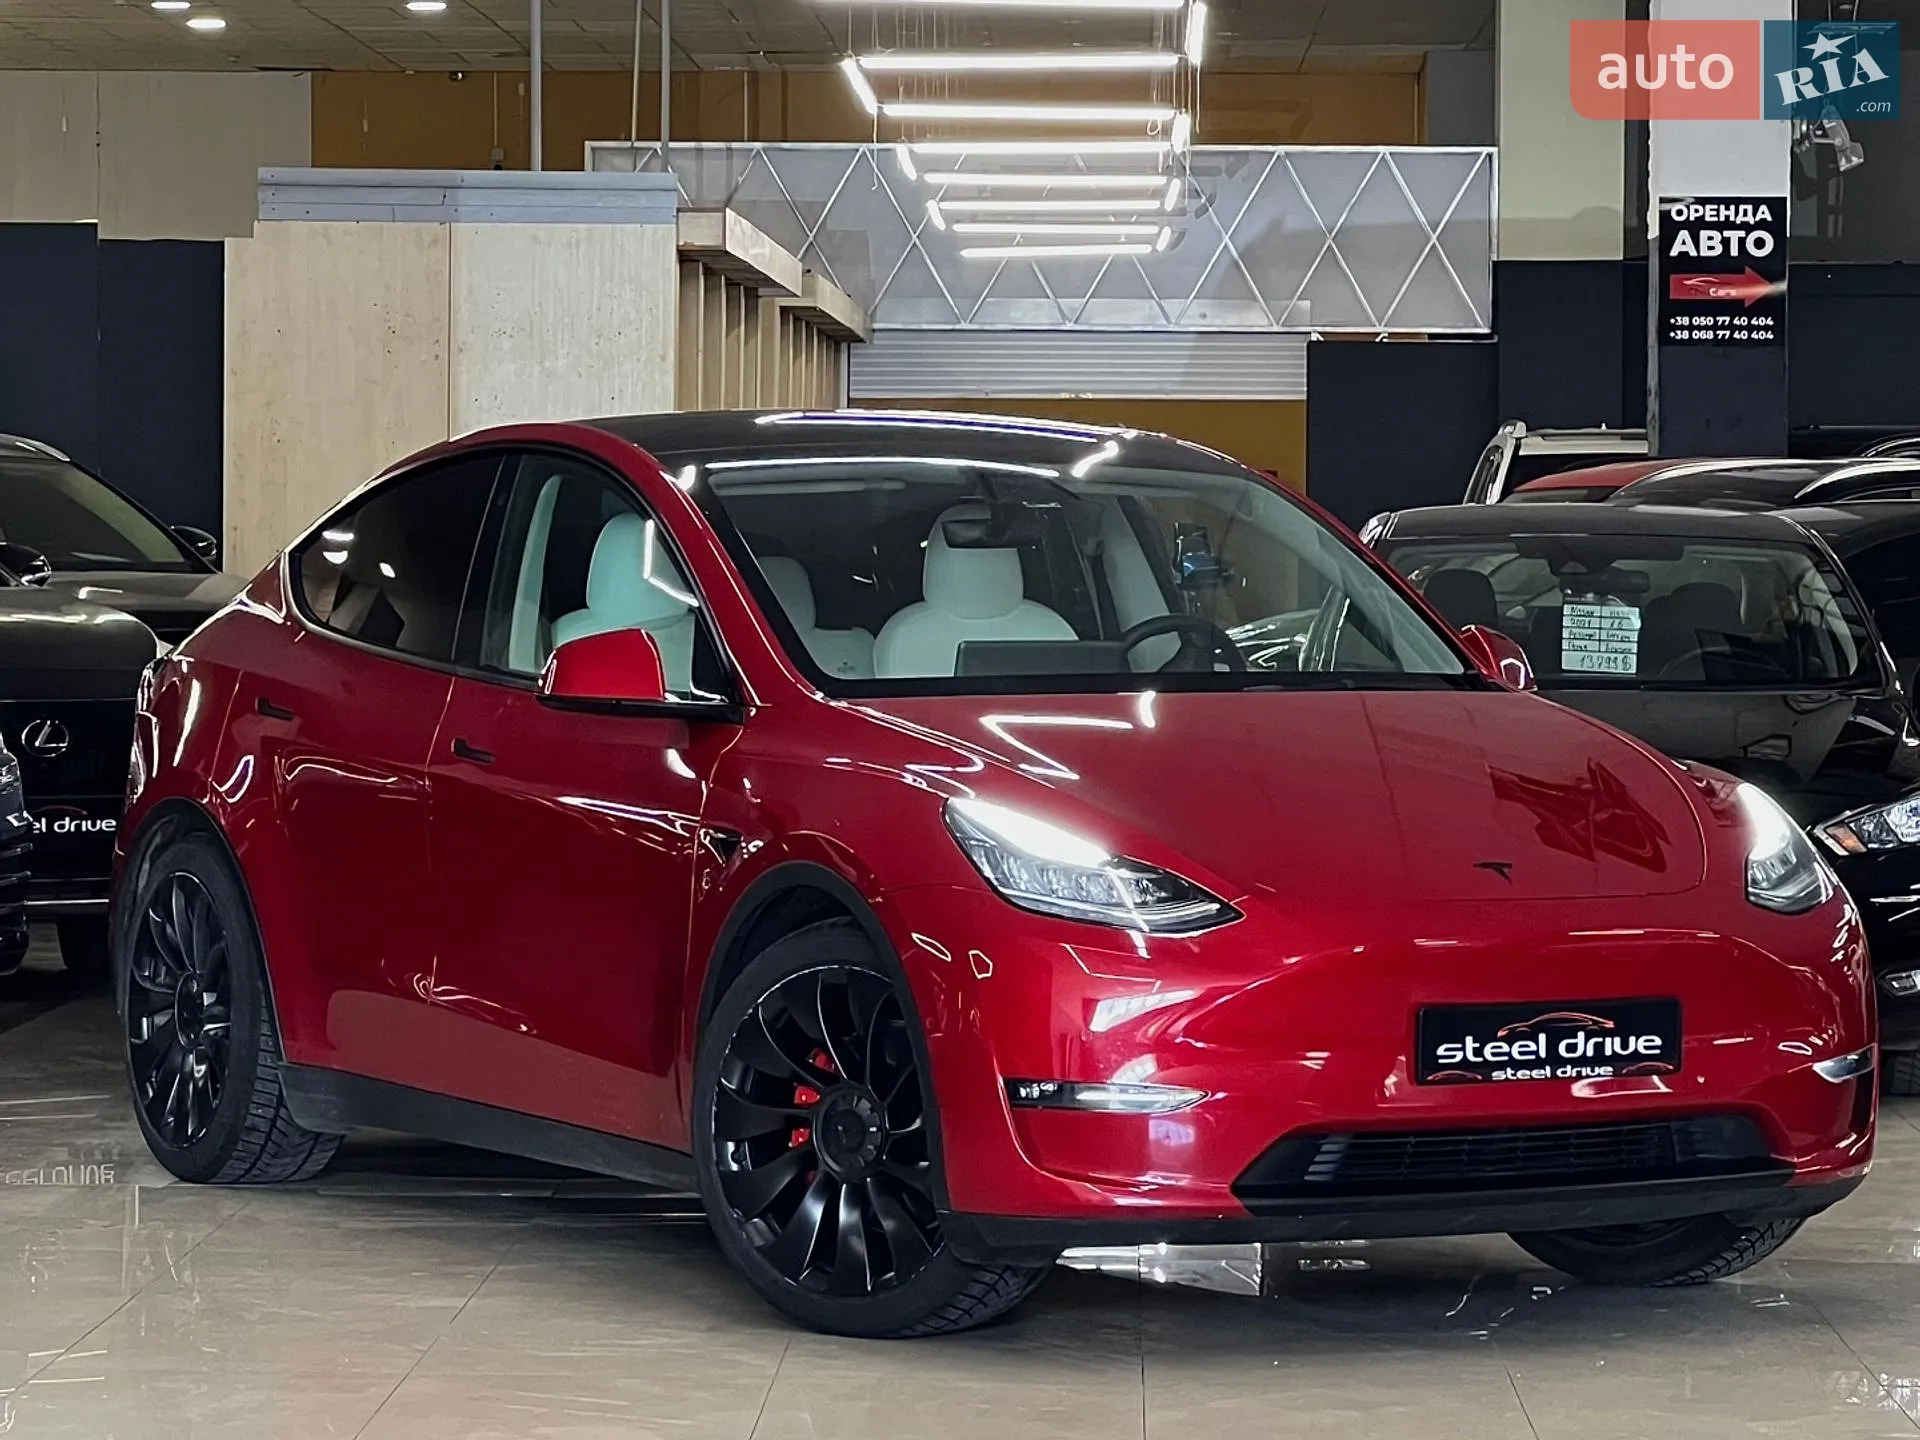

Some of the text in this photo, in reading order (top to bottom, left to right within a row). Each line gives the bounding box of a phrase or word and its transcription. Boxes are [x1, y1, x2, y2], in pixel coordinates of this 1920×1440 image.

[1670, 204, 1773, 225] ОРЕНДА
[1669, 229, 1775, 257] АВТО
[1669, 316, 1775, 326] +38 050 77 40 404
[1669, 329, 1775, 340] +38 068 77 40 404
[53, 816, 117, 833] drive
[1436, 1031, 1663, 1064] steel drive
[1491, 1064, 1614, 1081] steel drive
